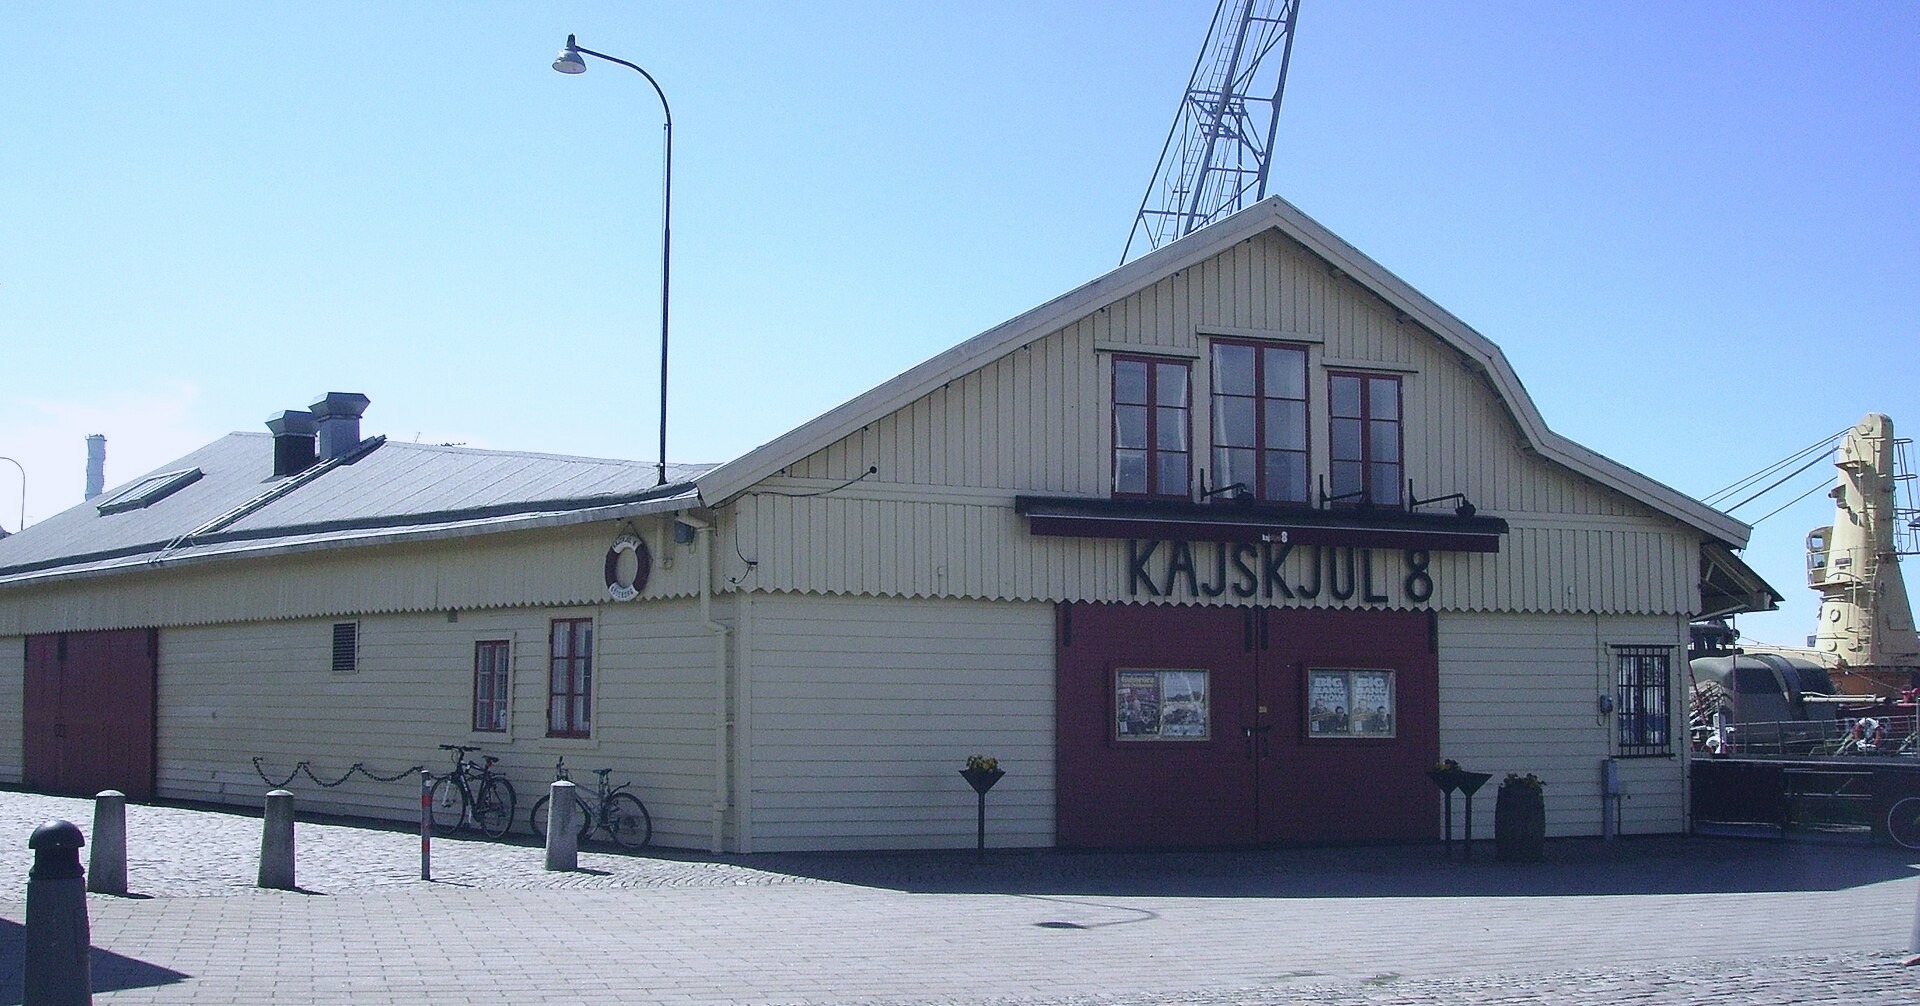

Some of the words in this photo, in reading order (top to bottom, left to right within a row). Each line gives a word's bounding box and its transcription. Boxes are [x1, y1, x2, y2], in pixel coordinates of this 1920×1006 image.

[1129, 539, 1389, 603] KAJSKJUL
[1404, 548, 1434, 603] 8
[1314, 676, 1343, 687] BIG
